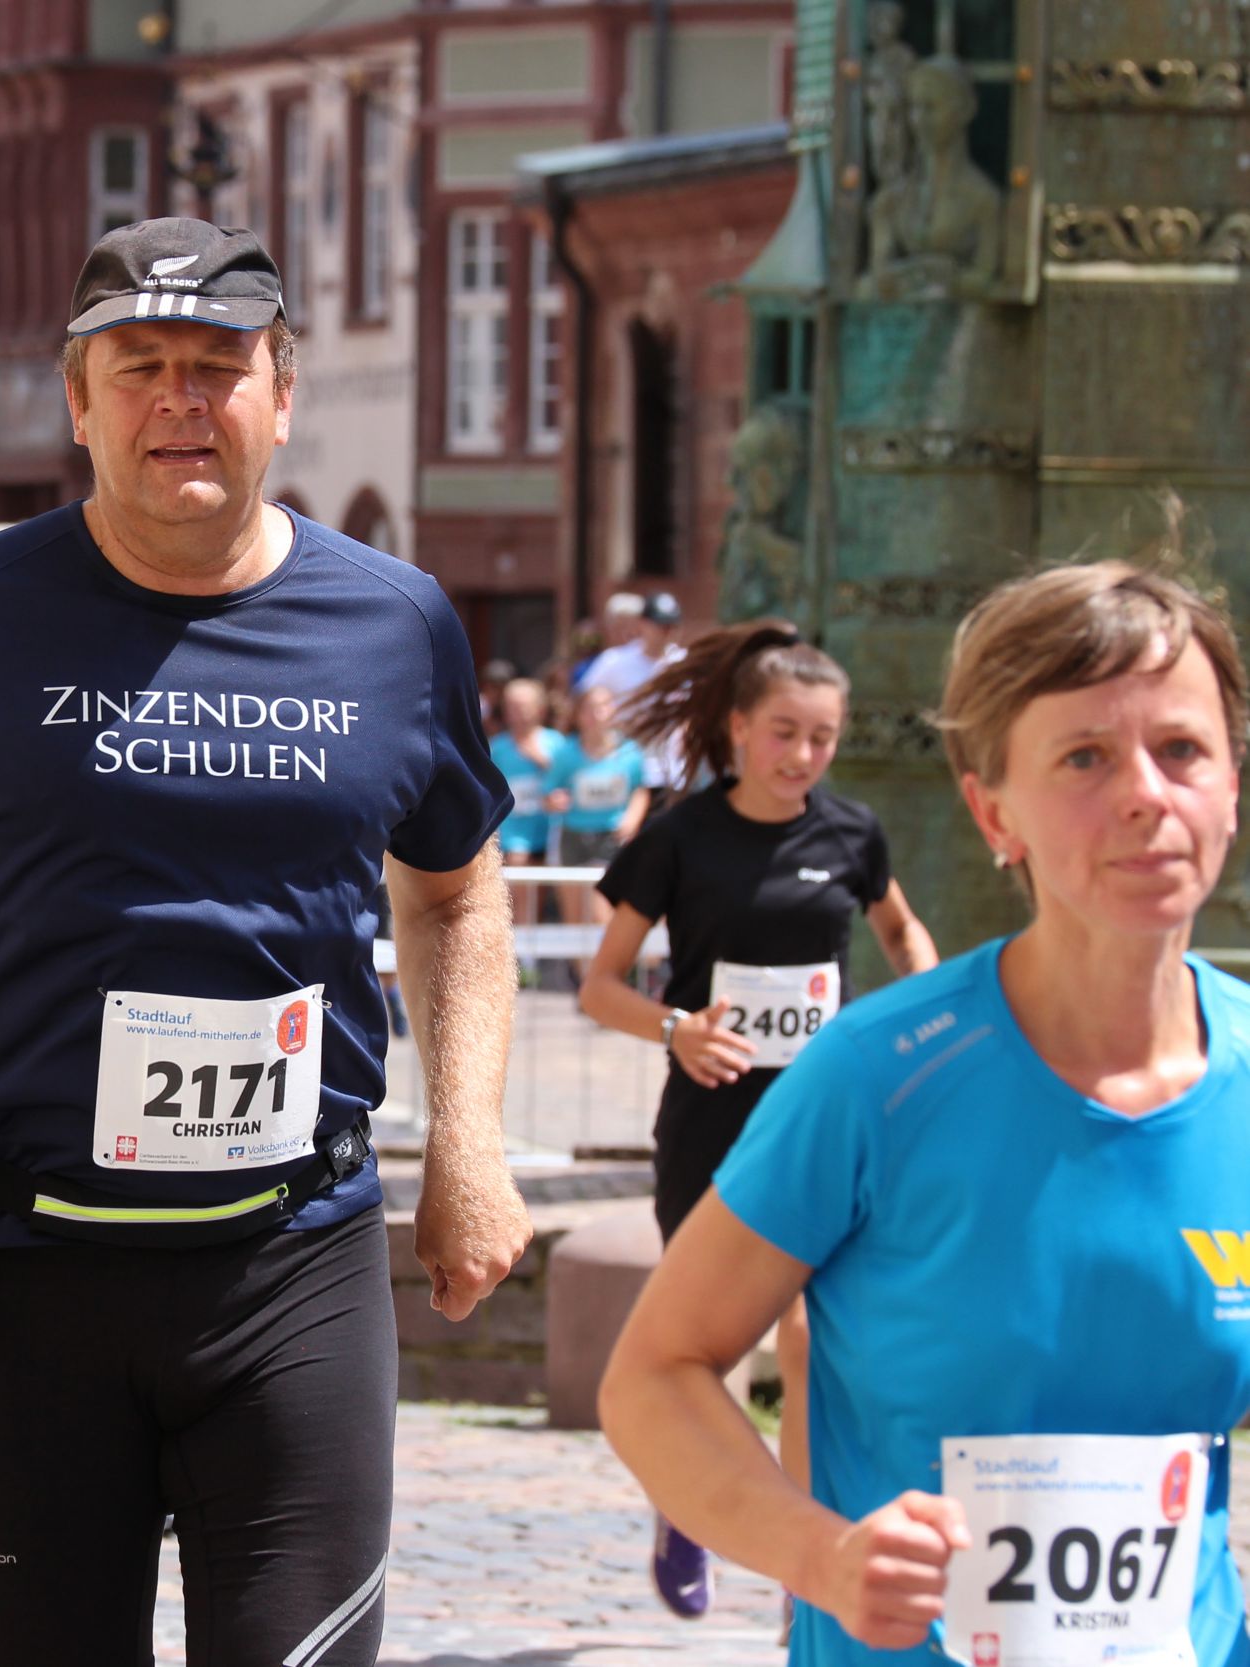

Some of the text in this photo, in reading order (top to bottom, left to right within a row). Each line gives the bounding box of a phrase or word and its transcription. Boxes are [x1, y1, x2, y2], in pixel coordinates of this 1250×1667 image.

[41, 686, 359, 735] ZINZENDORF
[94, 731, 326, 783] SCHULEN
[128, 1008, 192, 1025] Stadtlauf
[728, 1007, 821, 1037] 2408
[126, 1025, 261, 1041] www.laufend-mithelfen.de
[144, 1058, 287, 1118] 2171
[172, 1120, 261, 1137] CHRISTIAN
[248, 1139, 287, 1154] Volksbank
[988, 1526, 1178, 1603] 2067
[1054, 1611, 1130, 1630] KRISTINA
